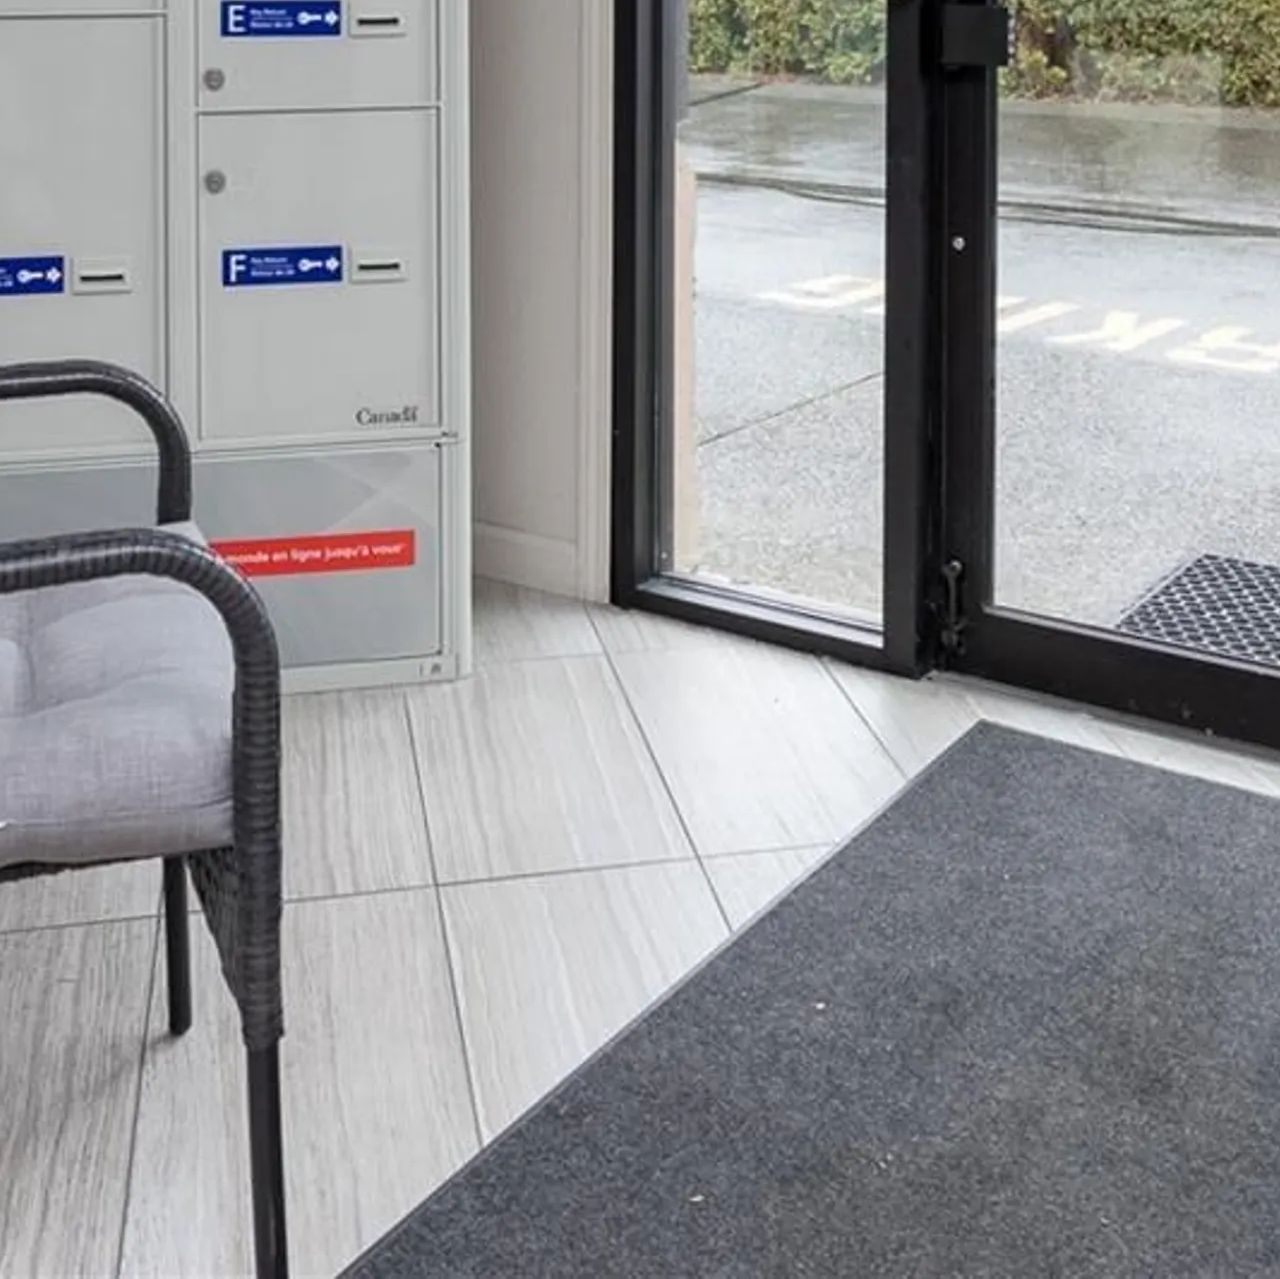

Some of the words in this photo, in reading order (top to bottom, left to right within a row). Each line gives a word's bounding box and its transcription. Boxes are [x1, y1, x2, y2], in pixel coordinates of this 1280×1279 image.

[227, 4, 247, 33] E
[229, 253, 247, 283] F
[272, 550, 288, 562] en
[290, 547, 322, 563] ligne
